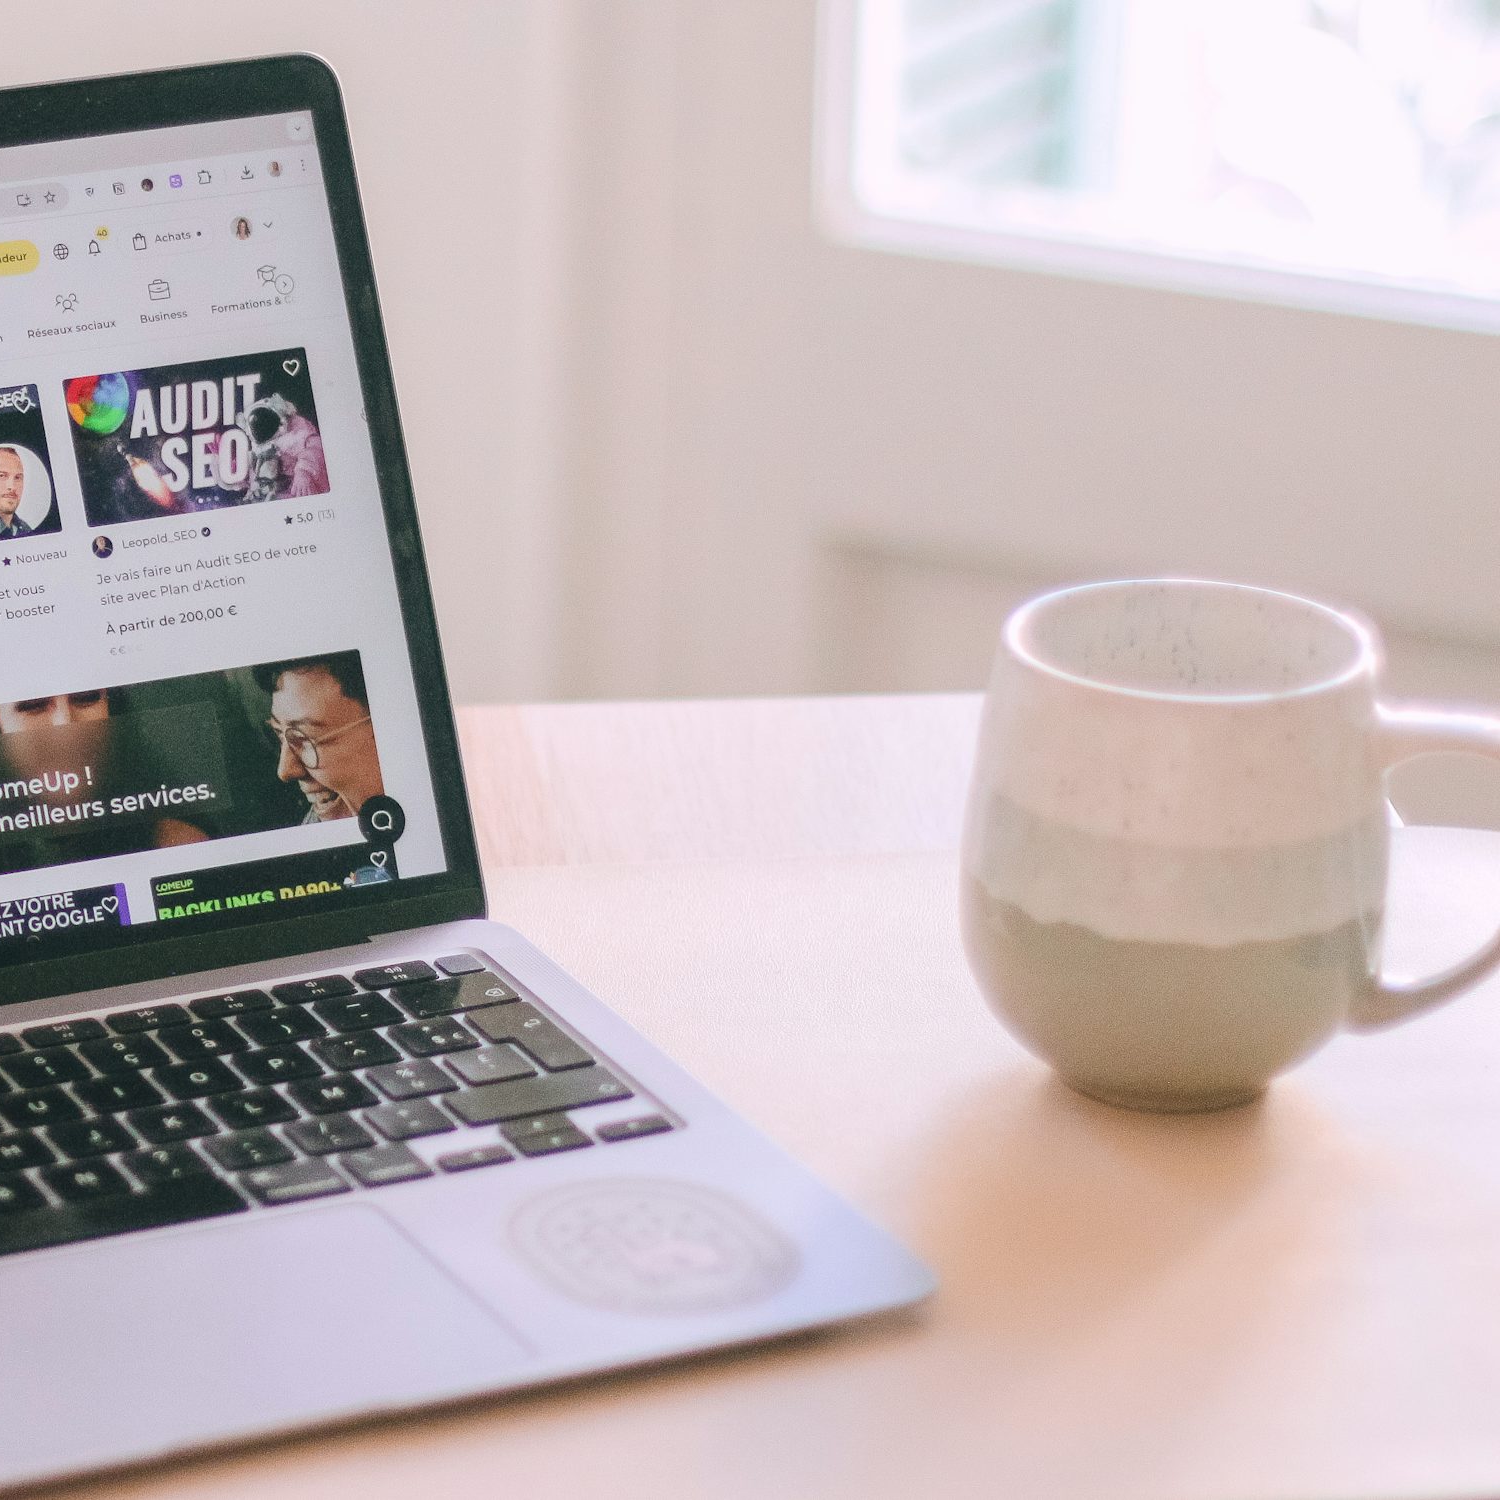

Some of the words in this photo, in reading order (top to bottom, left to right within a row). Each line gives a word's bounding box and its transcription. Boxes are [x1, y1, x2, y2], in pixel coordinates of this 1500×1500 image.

[154, 230, 191, 243] Achats
[211, 297, 272, 314] Formations
[140, 310, 188, 324] Business
[27, 325, 73, 339] Réseaux
[75, 320, 116, 333] sociaux
[130, 373, 261, 439] AUDIT
[161, 428, 250, 493] SEO
[122, 529, 197, 549] Leopold_SEO
[16, 550, 67, 565] Nouveau
[97, 574, 111, 585] Je
[115, 569, 140, 582] vais
[143, 562, 171, 578] faire
[175, 562, 192, 573] un
[195, 556, 231, 570] Audit
[234, 551, 260, 564] SEO
[264, 548, 281, 560] de
[284, 544, 317, 557] votre
[14, 584, 45, 597] vous
[100, 593, 123, 606] site
[127, 588, 157, 602] avec
[160, 583, 189, 597] Plan
[192, 575, 245, 592] d'Action
[6, 604, 56, 620] booster
[120, 618, 155, 635] partir
[159, 615, 175, 627] de
[179, 607, 224, 624] 200,00
[227, 605, 238, 616] €
[111, 782, 216, 814] services.
[156, 879, 193, 892] COMEUP
[15, 893, 75, 916] VOTRE
[27, 905, 105, 931] GOOGLE
